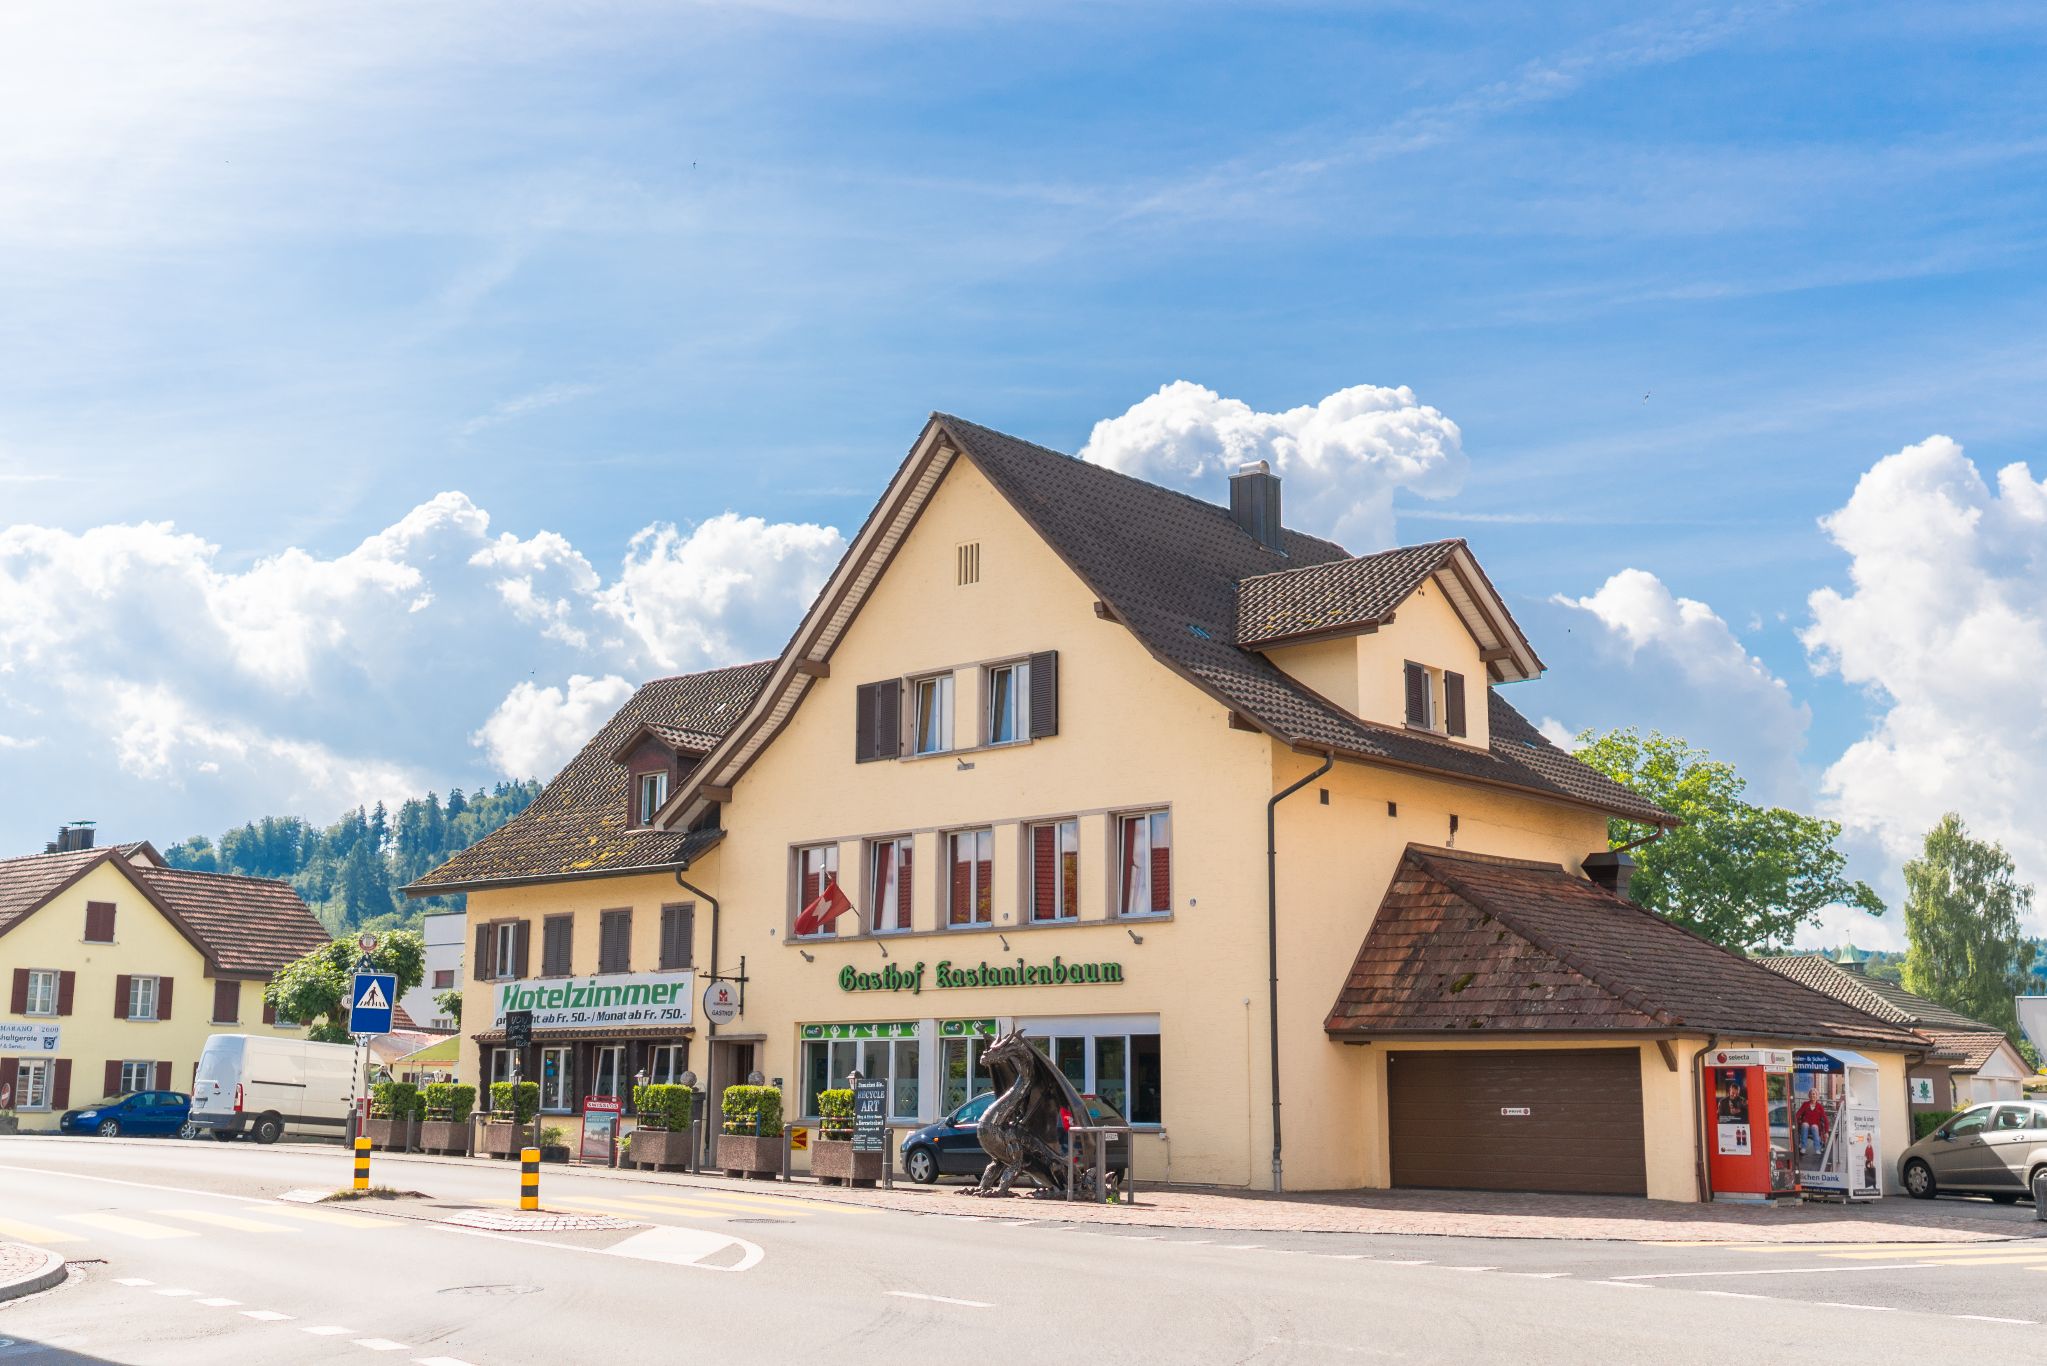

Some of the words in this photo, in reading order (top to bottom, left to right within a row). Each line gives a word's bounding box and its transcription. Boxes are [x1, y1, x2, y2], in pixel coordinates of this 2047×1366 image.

[838, 961, 925, 995] Gasthof
[935, 956, 1124, 989] Kastanienbaum
[502, 980, 685, 1011] Hotelzimmer
[495, 1016, 507, 1027] pr
[541, 1013, 555, 1023] ab
[556, 1012, 569, 1023] Fr.
[596, 1010, 627, 1021] Monat
[627, 1009, 642, 1020] ab
[643, 1009, 657, 1020] Fr.
[660, 1008, 686, 1019] 750.-
[858, 1091, 884, 1099] RECYCLE
[861, 1101, 880, 1112] ART
[1821, 1174, 1840, 1182] Dank
